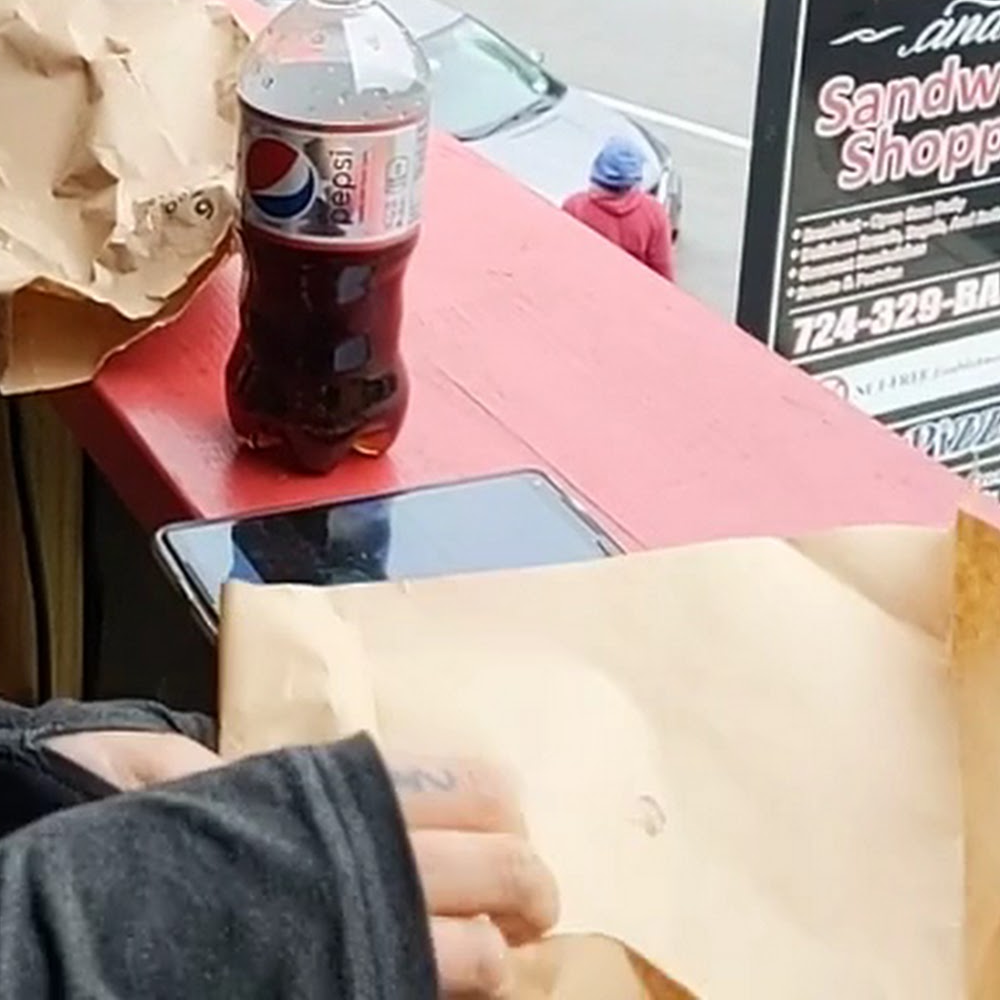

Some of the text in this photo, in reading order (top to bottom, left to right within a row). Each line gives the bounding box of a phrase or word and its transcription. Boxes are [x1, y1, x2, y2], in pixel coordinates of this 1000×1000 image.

[815, 54, 1000, 137] Sandw
[328, 149, 356, 226] pepsi
[837, 121, 1000, 191] Shopp
[793, 272, 1000, 354] 724-329-BA
